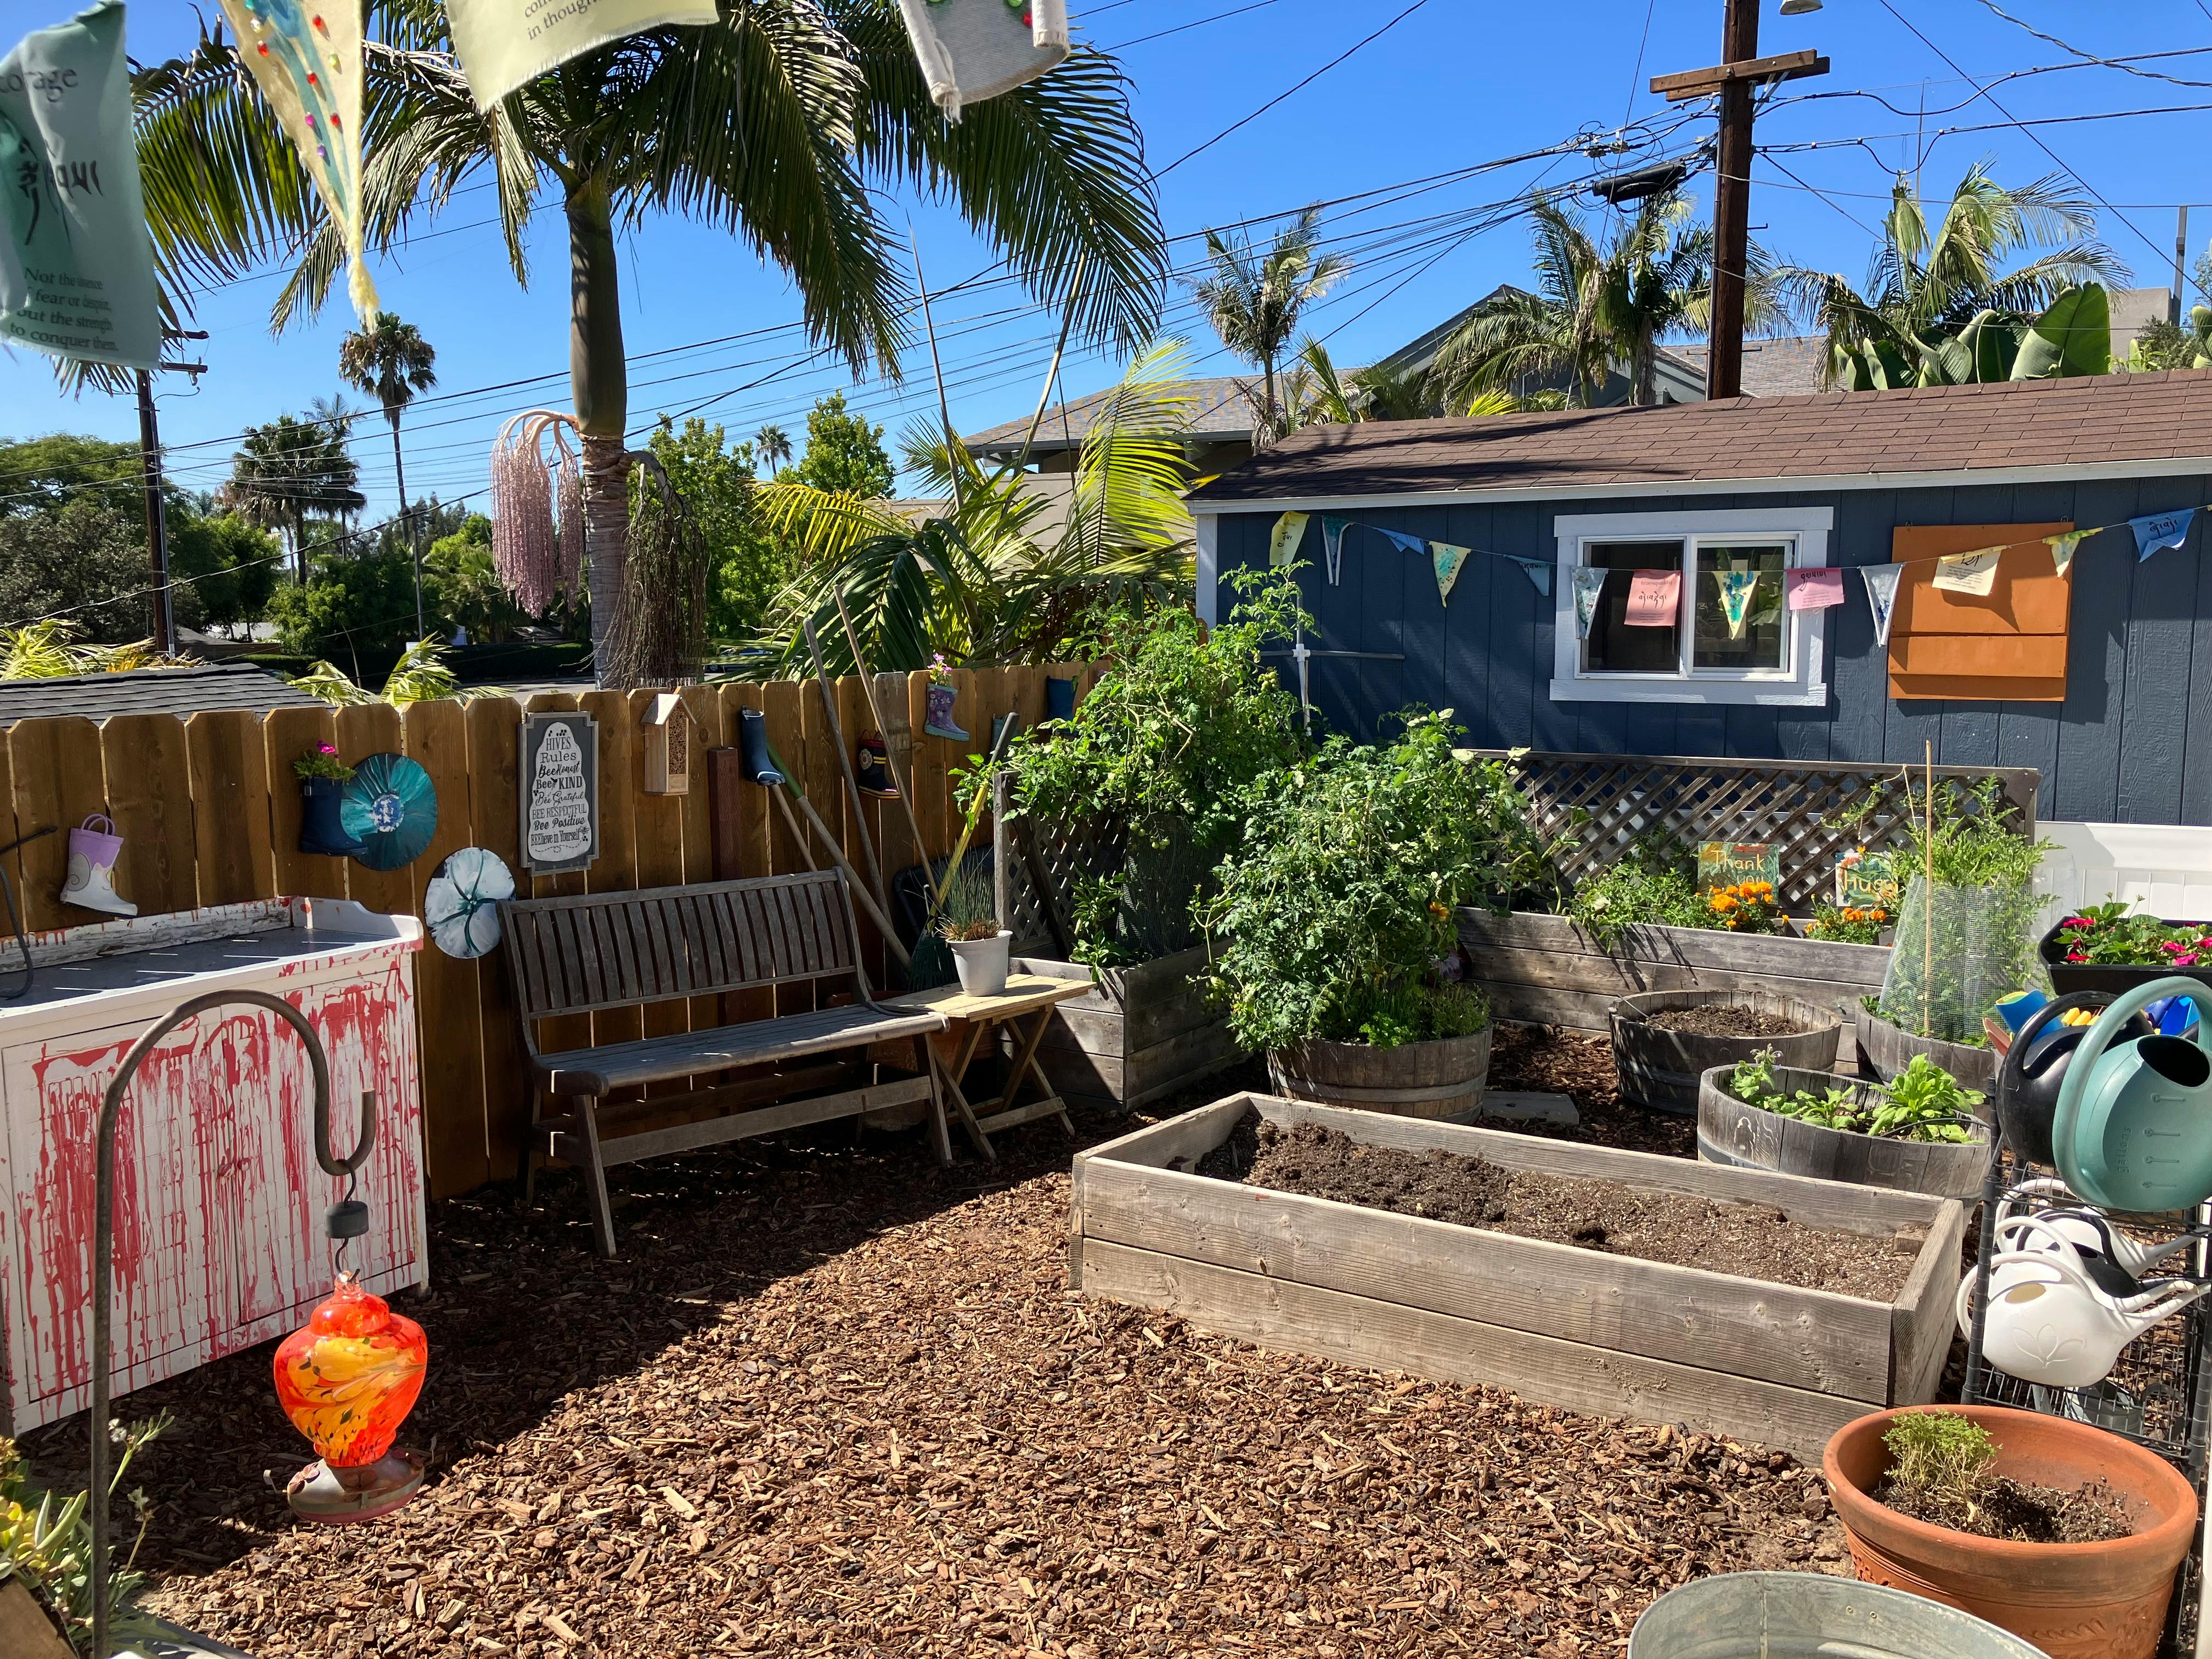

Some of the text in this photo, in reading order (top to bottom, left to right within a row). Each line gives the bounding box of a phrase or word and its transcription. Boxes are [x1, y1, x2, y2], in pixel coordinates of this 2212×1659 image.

[527, 0, 597, 40] in thoug
[24, 267, 55, 284] Not
[59, 273, 76, 286] the
[35, 289, 65, 305] fear
[68, 297, 80, 307] or
[50, 311, 73, 326] the
[10, 321, 25, 336] to
[30, 330, 91, 349] conquer
[546, 736, 571, 751] HIVES
[540, 751, 577, 763] Rules
[536, 776, 583, 790] Bee KIND
[535, 790, 584, 808] Bee Grateful
[532, 804, 587, 820] BEE RESPECTFUL
[534, 815, 586, 831] Bee Positive
[554, 834, 559, 843] in
[559, 828, 580, 842] Yourself
[1711, 850, 1765, 872] Thank
